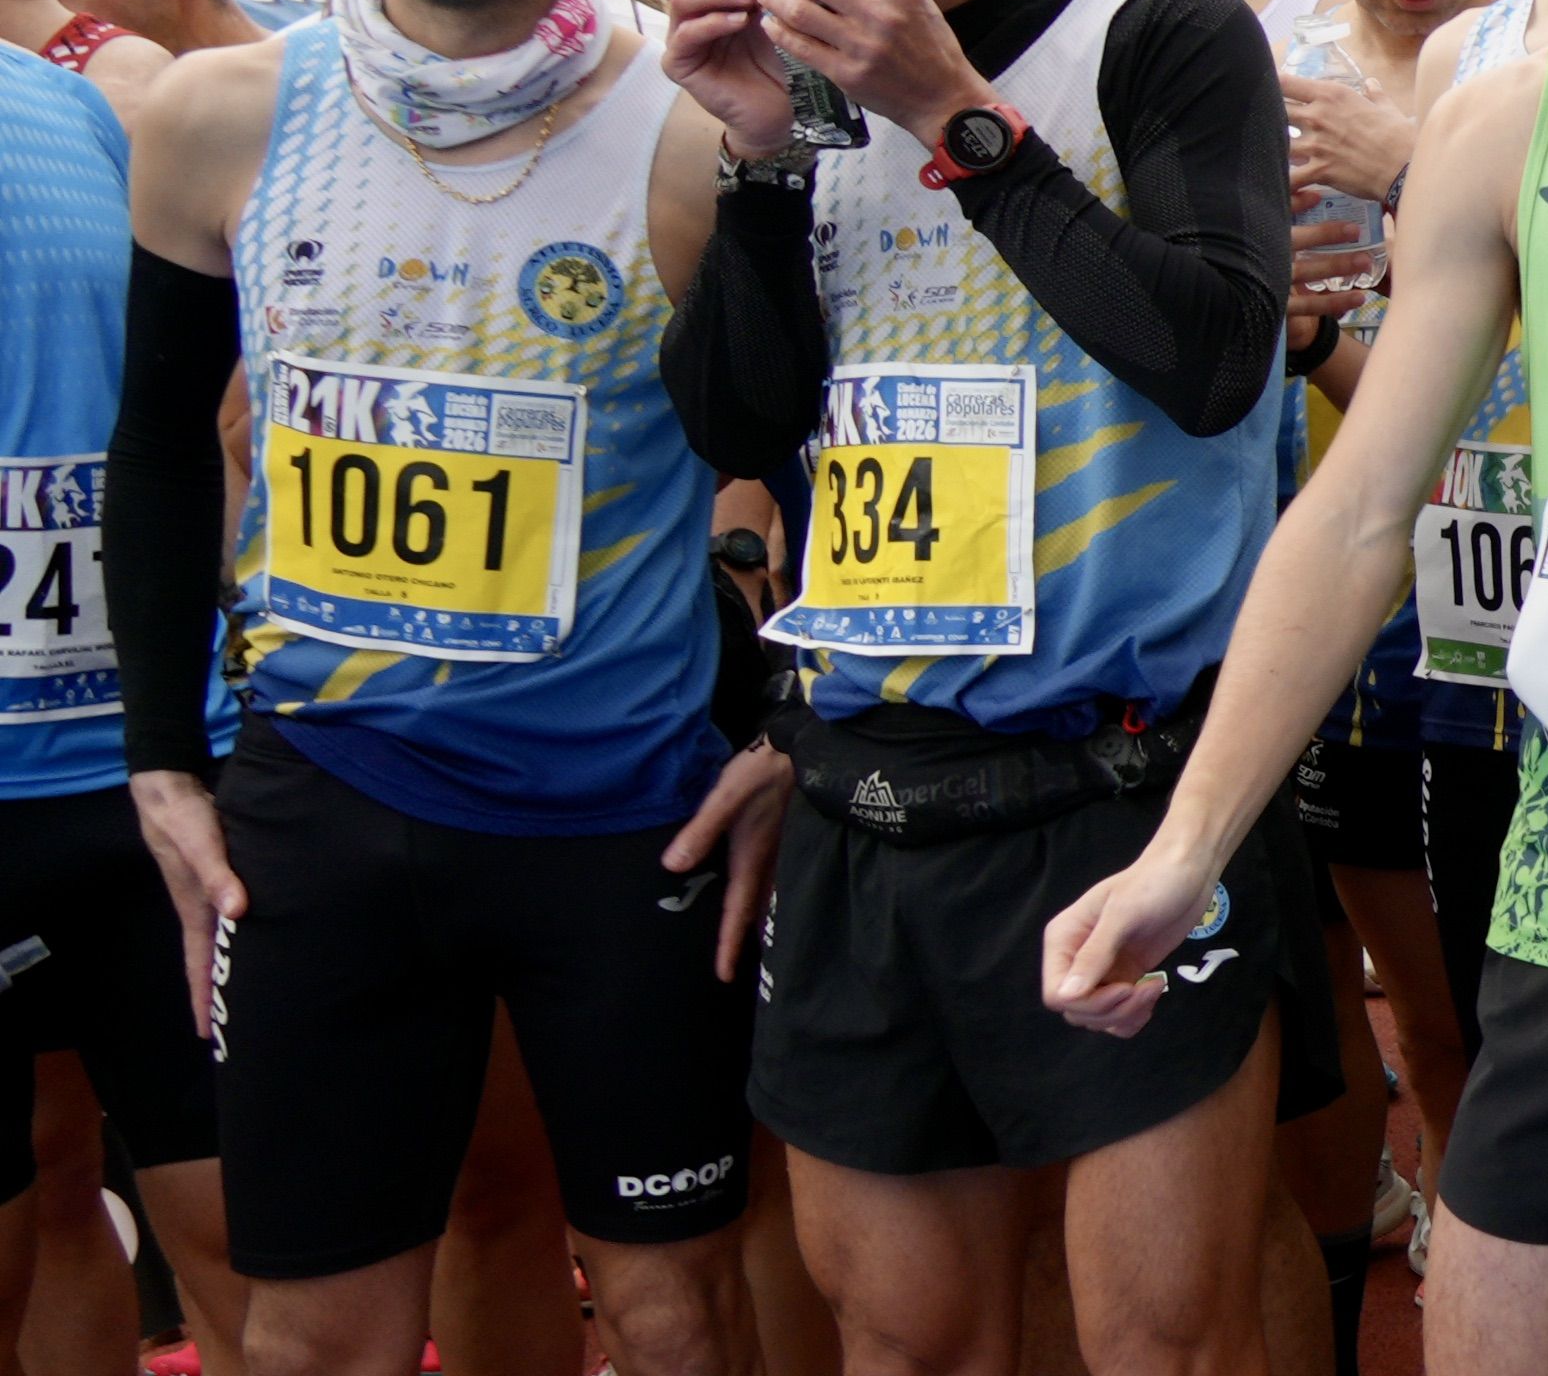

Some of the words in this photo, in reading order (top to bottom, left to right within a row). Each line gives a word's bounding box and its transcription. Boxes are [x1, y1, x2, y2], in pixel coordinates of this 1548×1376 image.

[283, 367, 383, 445] 21K
[945, 392, 1006, 407] carreras
[945, 403, 1016, 420] populares
[441, 428, 487, 454] 2026
[896, 419, 937, 441] 2026
[290, 447, 512, 573] 1061
[828, 456, 941, 566] 334
[1440, 518, 1540, 613] 106
[849, 804, 907, 824] AONIJIE
